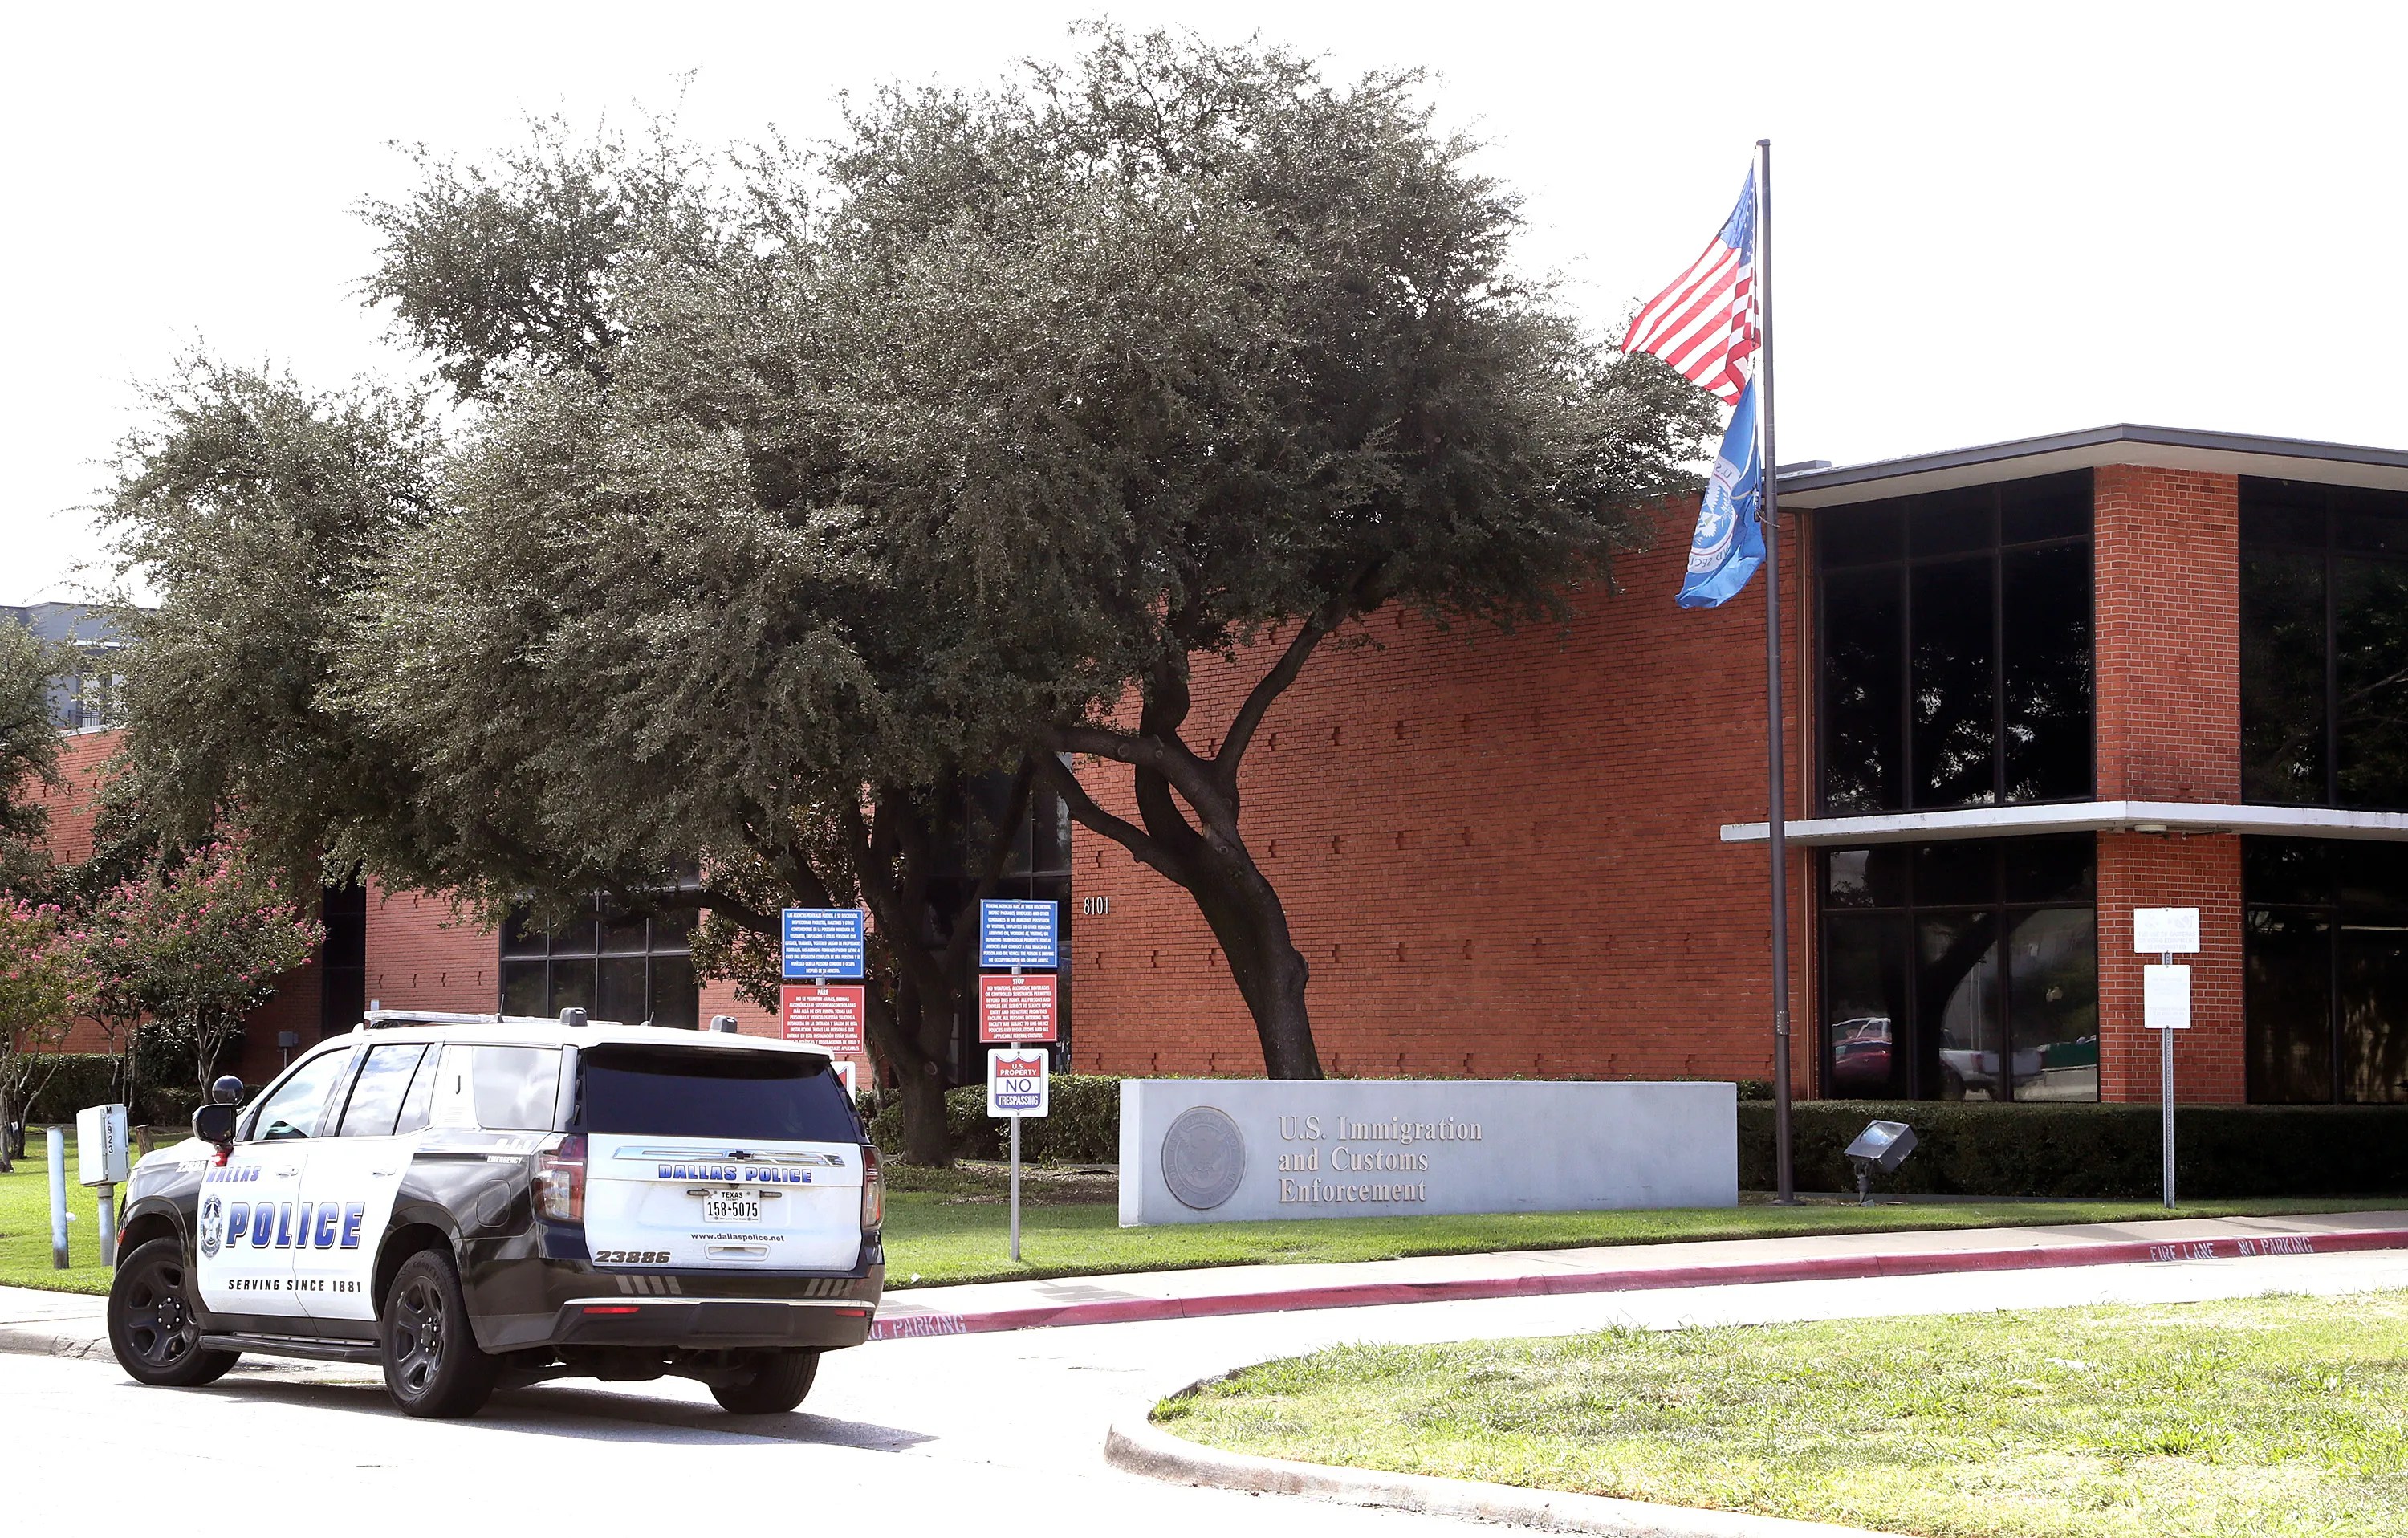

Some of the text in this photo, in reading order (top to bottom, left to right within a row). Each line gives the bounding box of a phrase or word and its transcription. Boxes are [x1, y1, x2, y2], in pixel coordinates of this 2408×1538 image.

[1084, 896, 1109, 915] 8101
[1006, 1079, 1031, 1092] NO
[998, 1095, 1039, 1105] TRESPASSING
[1279, 1116, 1483, 1145] U.S. Immigration
[486, 1155, 523, 1164] EMERGENCY
[1279, 1146, 1429, 1171] and Customs
[205, 1165, 262, 1183] DALLAS
[658, 1164, 812, 1183] DALLAS POLICE
[1279, 1178, 1426, 1202] Enforcement
[226, 1202, 365, 1249] POLICE
[690, 1232, 785, 1243] www.dallaspolice.net
[595, 1251, 671, 1263] 23886
[2150, 1245, 2182, 1262] FIRE
[2182, 1242, 2219, 1260] LANE
[2260, 1237, 2313, 1255] PARKING
[228, 1280, 361, 1293] SERVING SINCE 1881
[893, 1314, 967, 1338] PARKING
